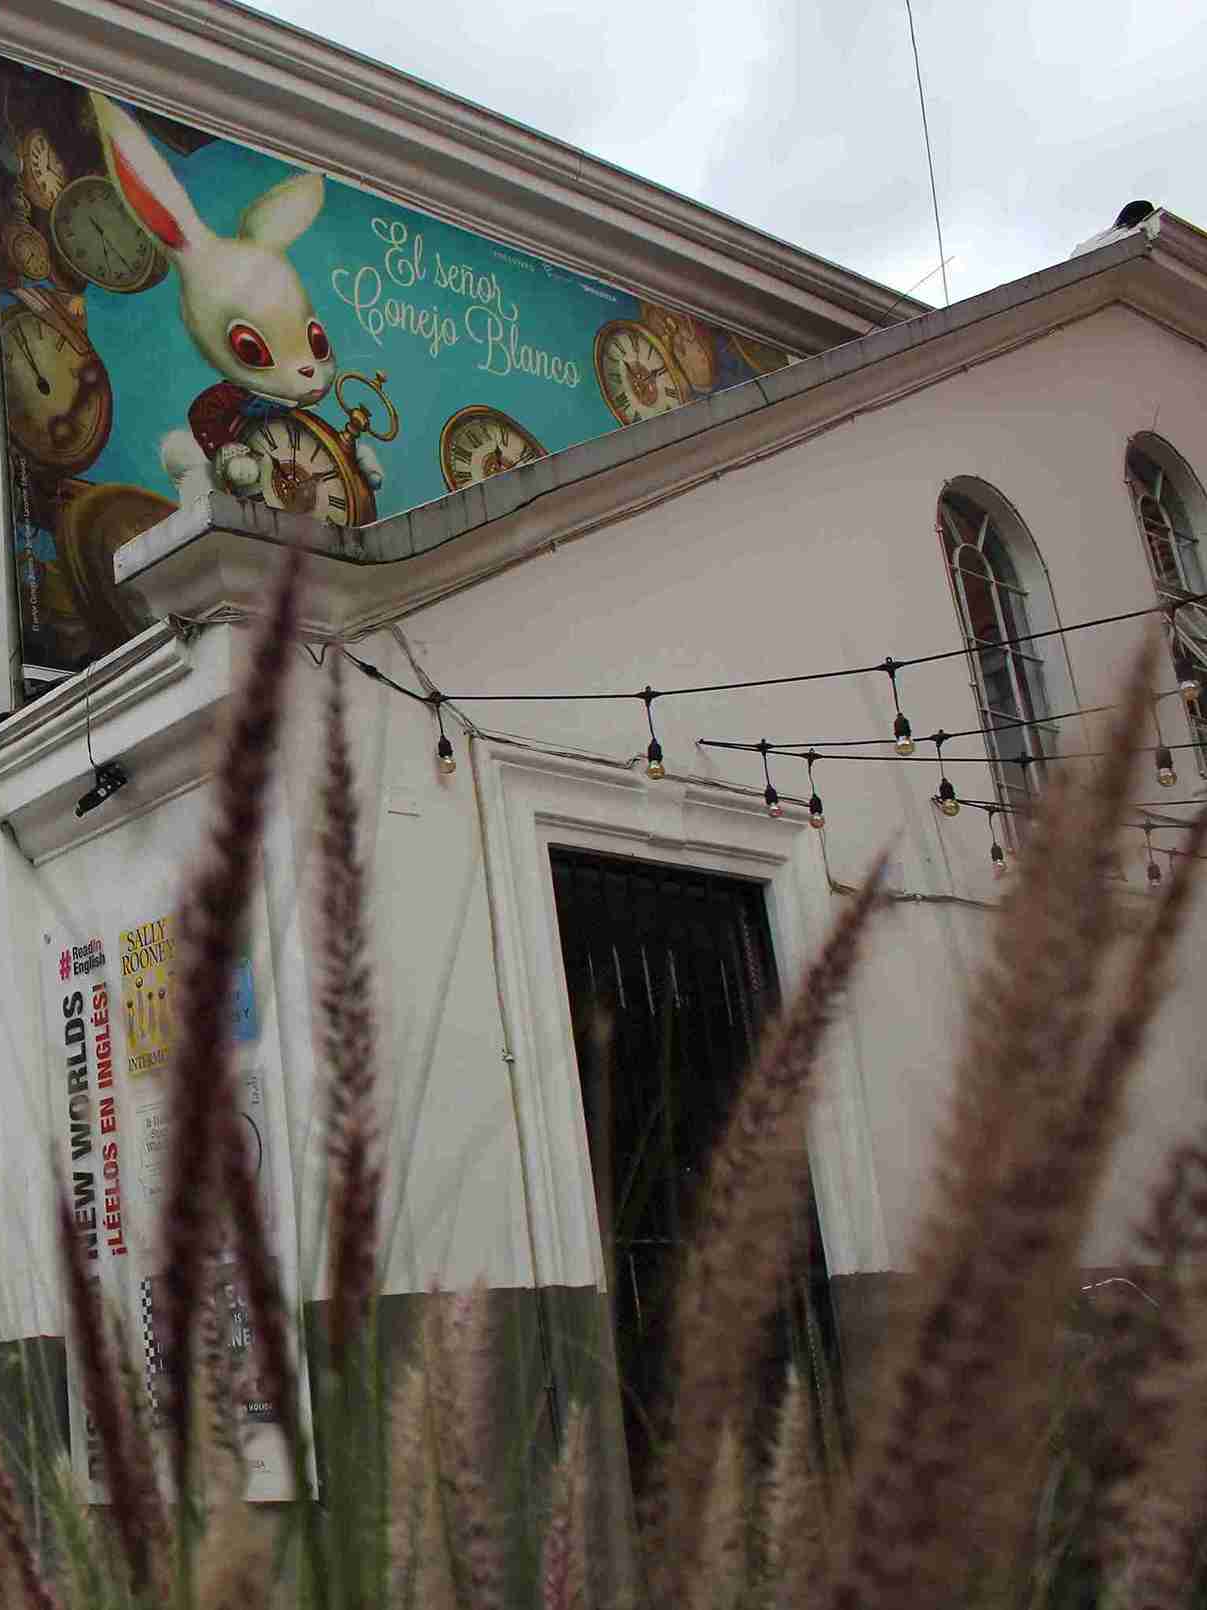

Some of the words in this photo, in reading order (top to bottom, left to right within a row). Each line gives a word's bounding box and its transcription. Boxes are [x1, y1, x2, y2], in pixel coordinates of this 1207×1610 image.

[371, 217, 427, 287] El
[434, 252, 519, 322] señor
[331, 266, 460, 358] Conejo
[464, 305, 581, 388] Blanco
[73, 952, 106, 976] English
[127, 919, 169, 952] SALLY
[62, 991, 92, 1162] WORLDS
[99, 1096, 116, 1136] EN
[73, 1171, 99, 1260] NEW
